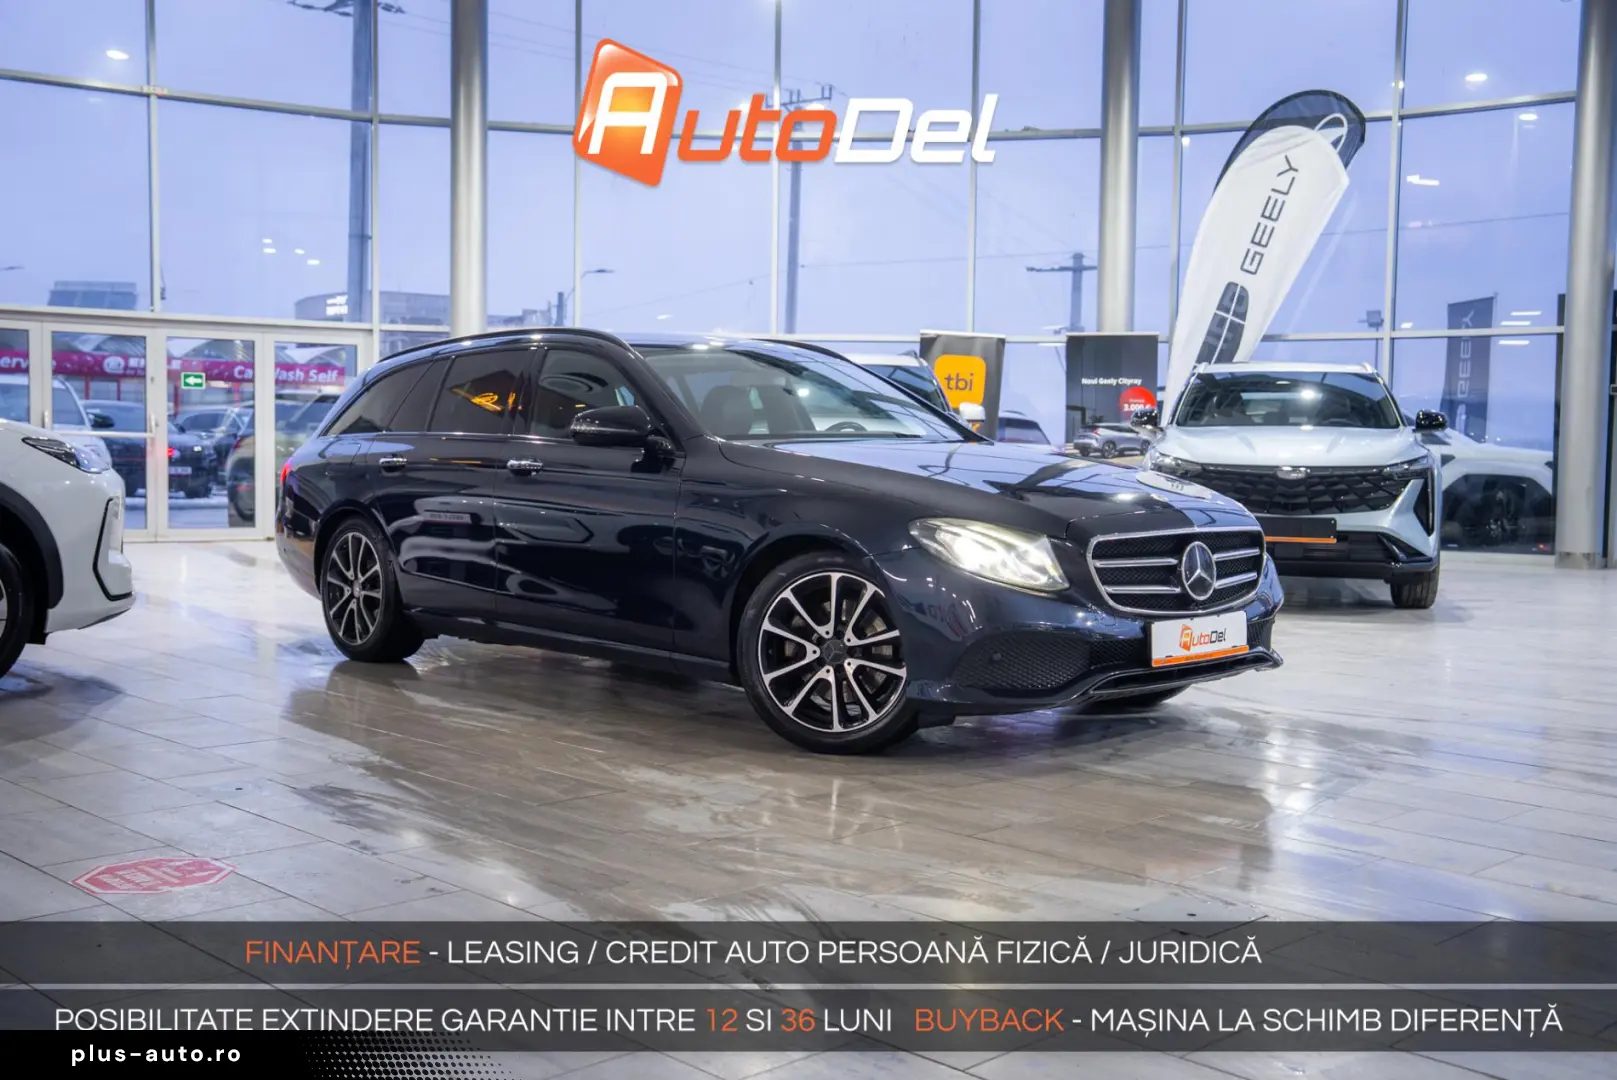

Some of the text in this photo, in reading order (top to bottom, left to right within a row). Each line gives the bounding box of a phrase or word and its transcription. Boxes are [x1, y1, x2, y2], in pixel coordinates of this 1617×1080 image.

[1240, 155, 1298, 275] GEELY
[275, 368, 304, 381] ash
[308, 369, 338, 382] Self
[944, 372, 975, 391] tbi
[1098, 378, 1117, 386] Geely
[1118, 378, 1142, 386] Cityray
[1180, 627, 1226, 648] AutoDel
